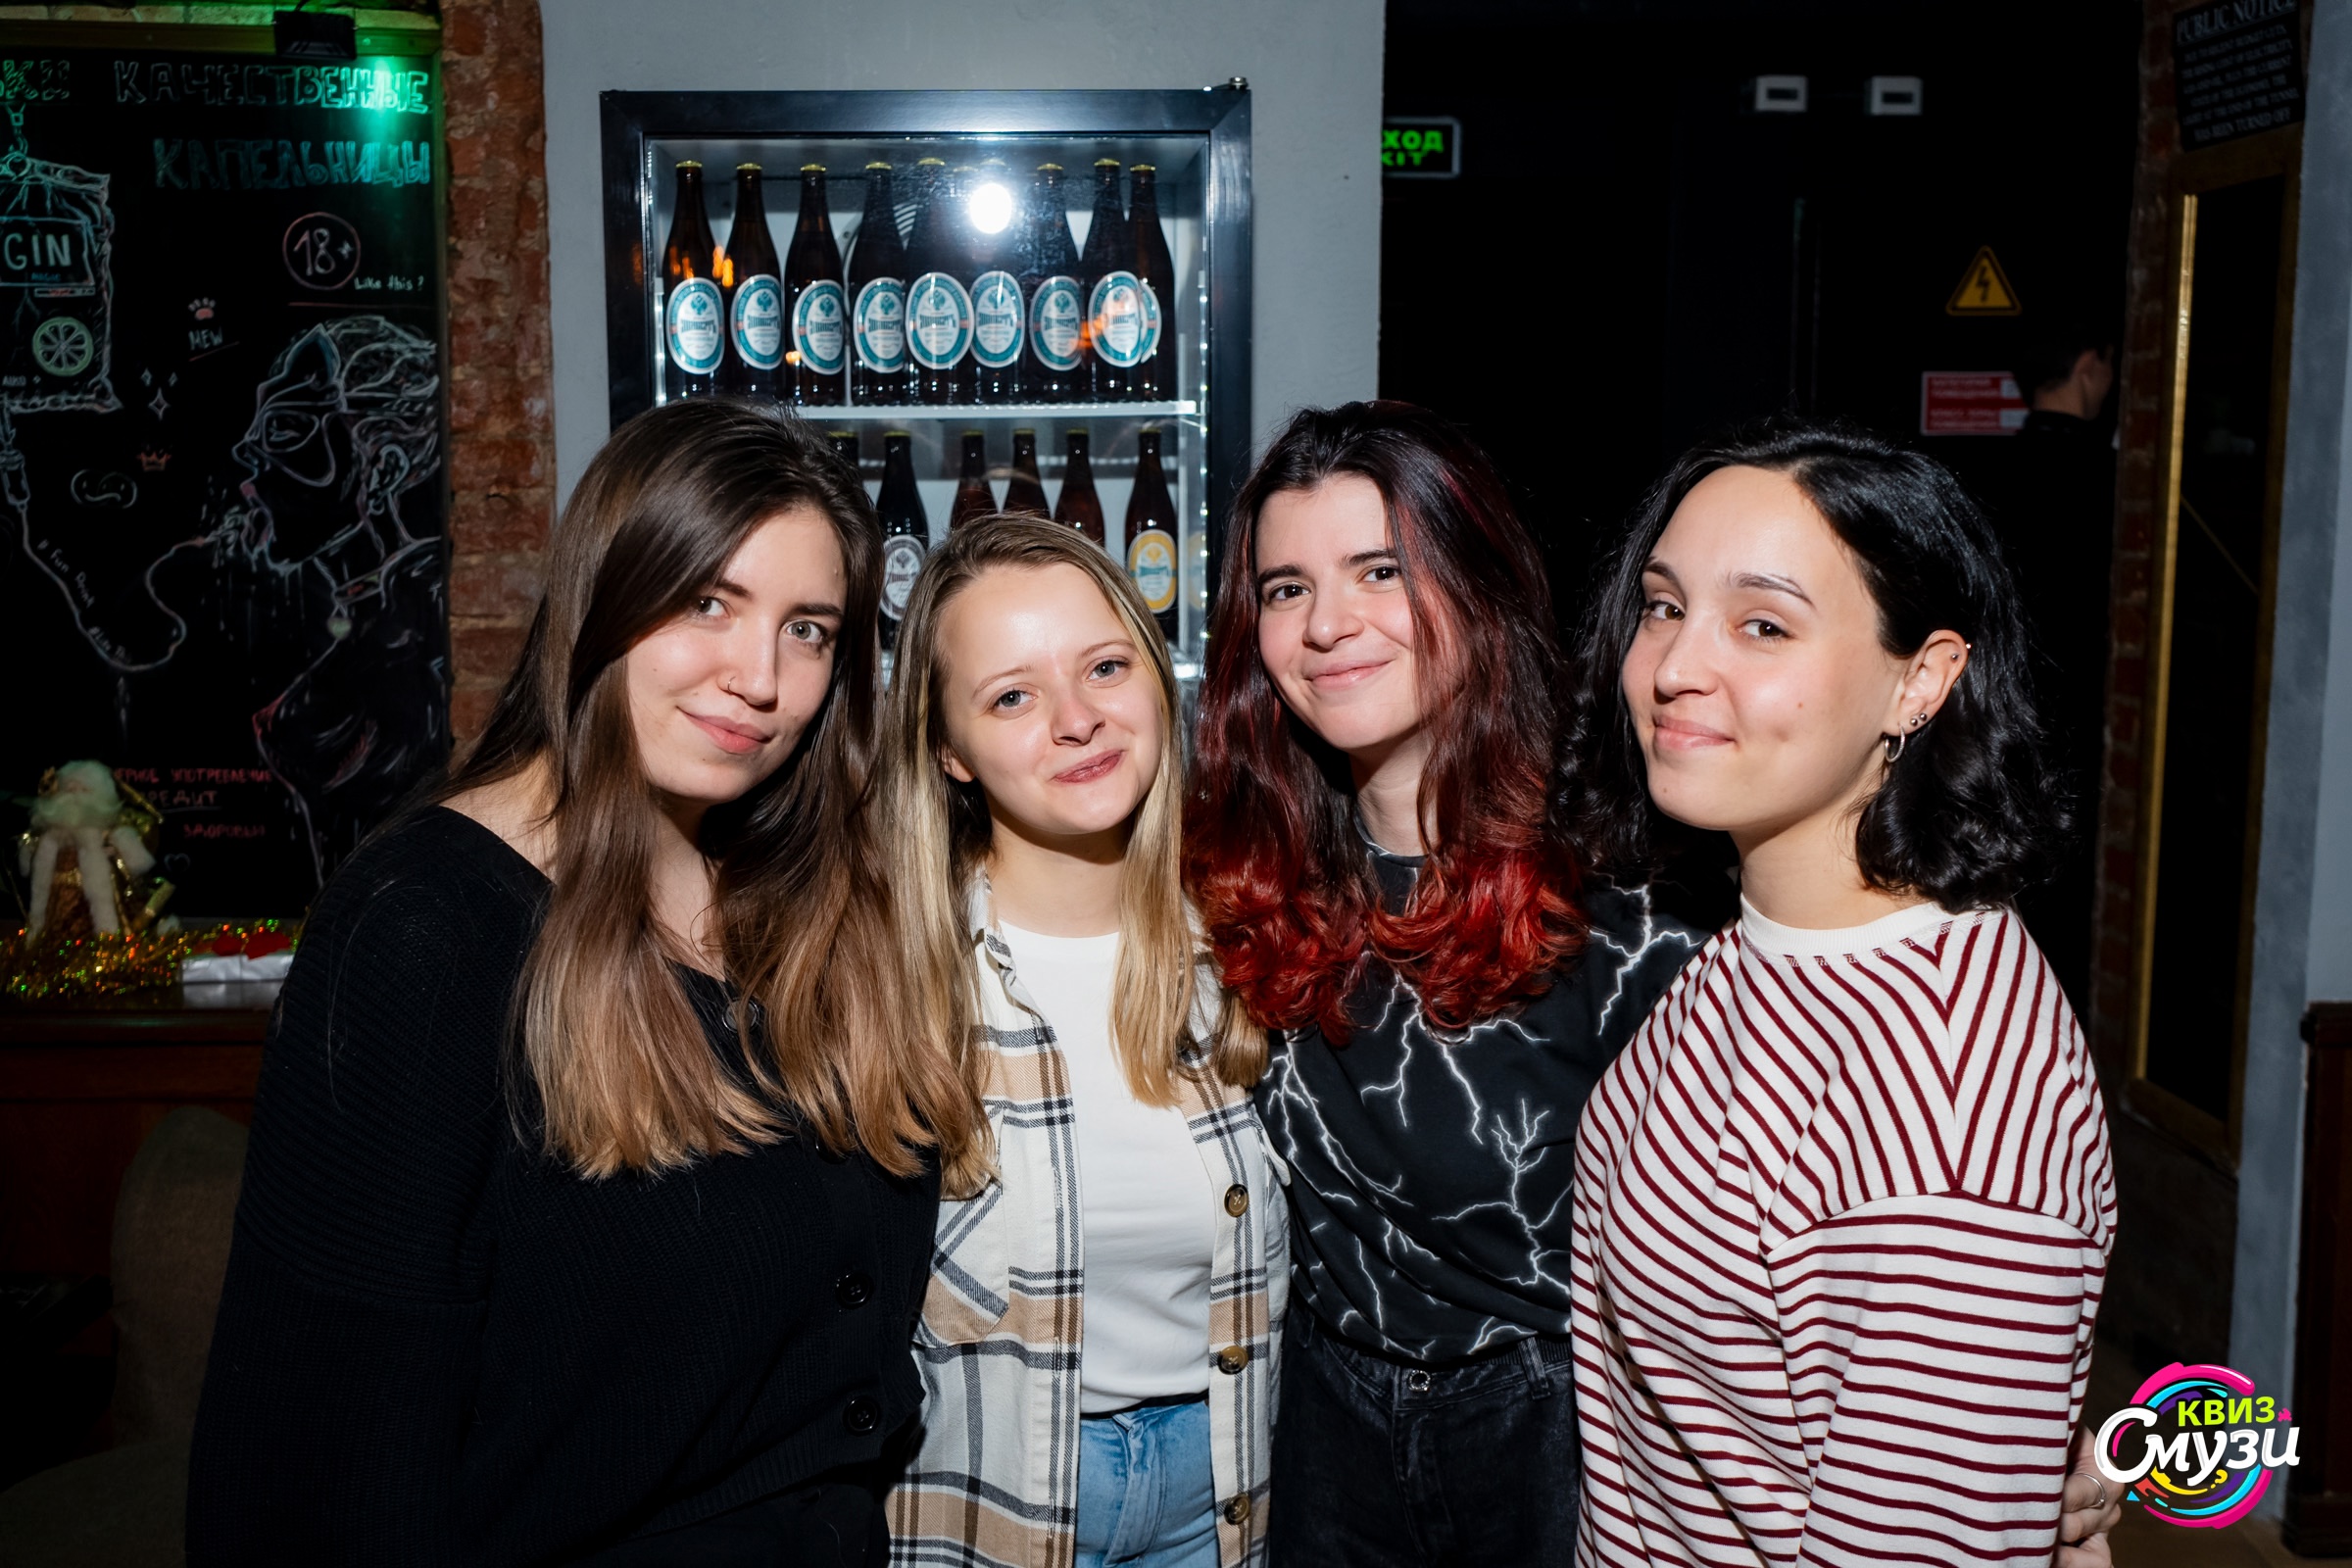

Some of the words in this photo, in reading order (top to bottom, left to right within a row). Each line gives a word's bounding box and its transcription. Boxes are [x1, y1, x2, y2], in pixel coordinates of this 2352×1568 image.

[2176, 4, 2230, 47] PUBLIC
[113, 59, 431, 115] КАЧЕСТВЕННЫЕ
[152, 136, 431, 190] КАПЕЛЬНИЦЫ
[4, 232, 72, 270] GIN
[142, 789, 219, 808] РЕДИТ
